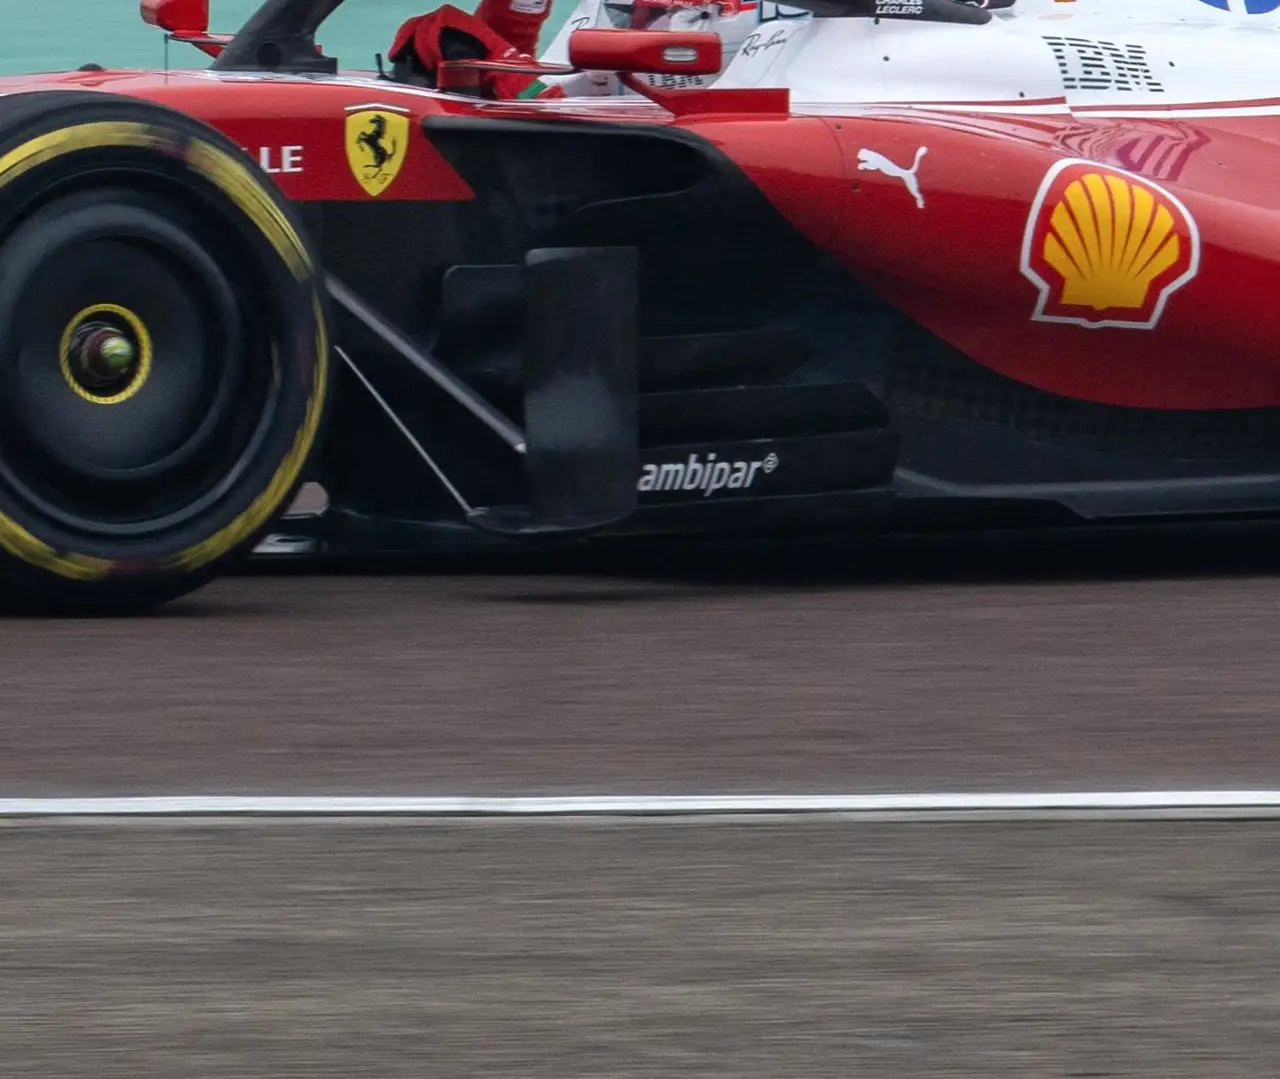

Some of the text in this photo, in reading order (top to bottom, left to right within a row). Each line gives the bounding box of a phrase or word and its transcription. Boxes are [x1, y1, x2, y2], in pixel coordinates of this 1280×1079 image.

[875, 5, 923, 14] LECLERC
[1041, 35, 1165, 92] IBM
[241, 145, 304, 173] LE
[637, 453, 762, 497] ambipar
